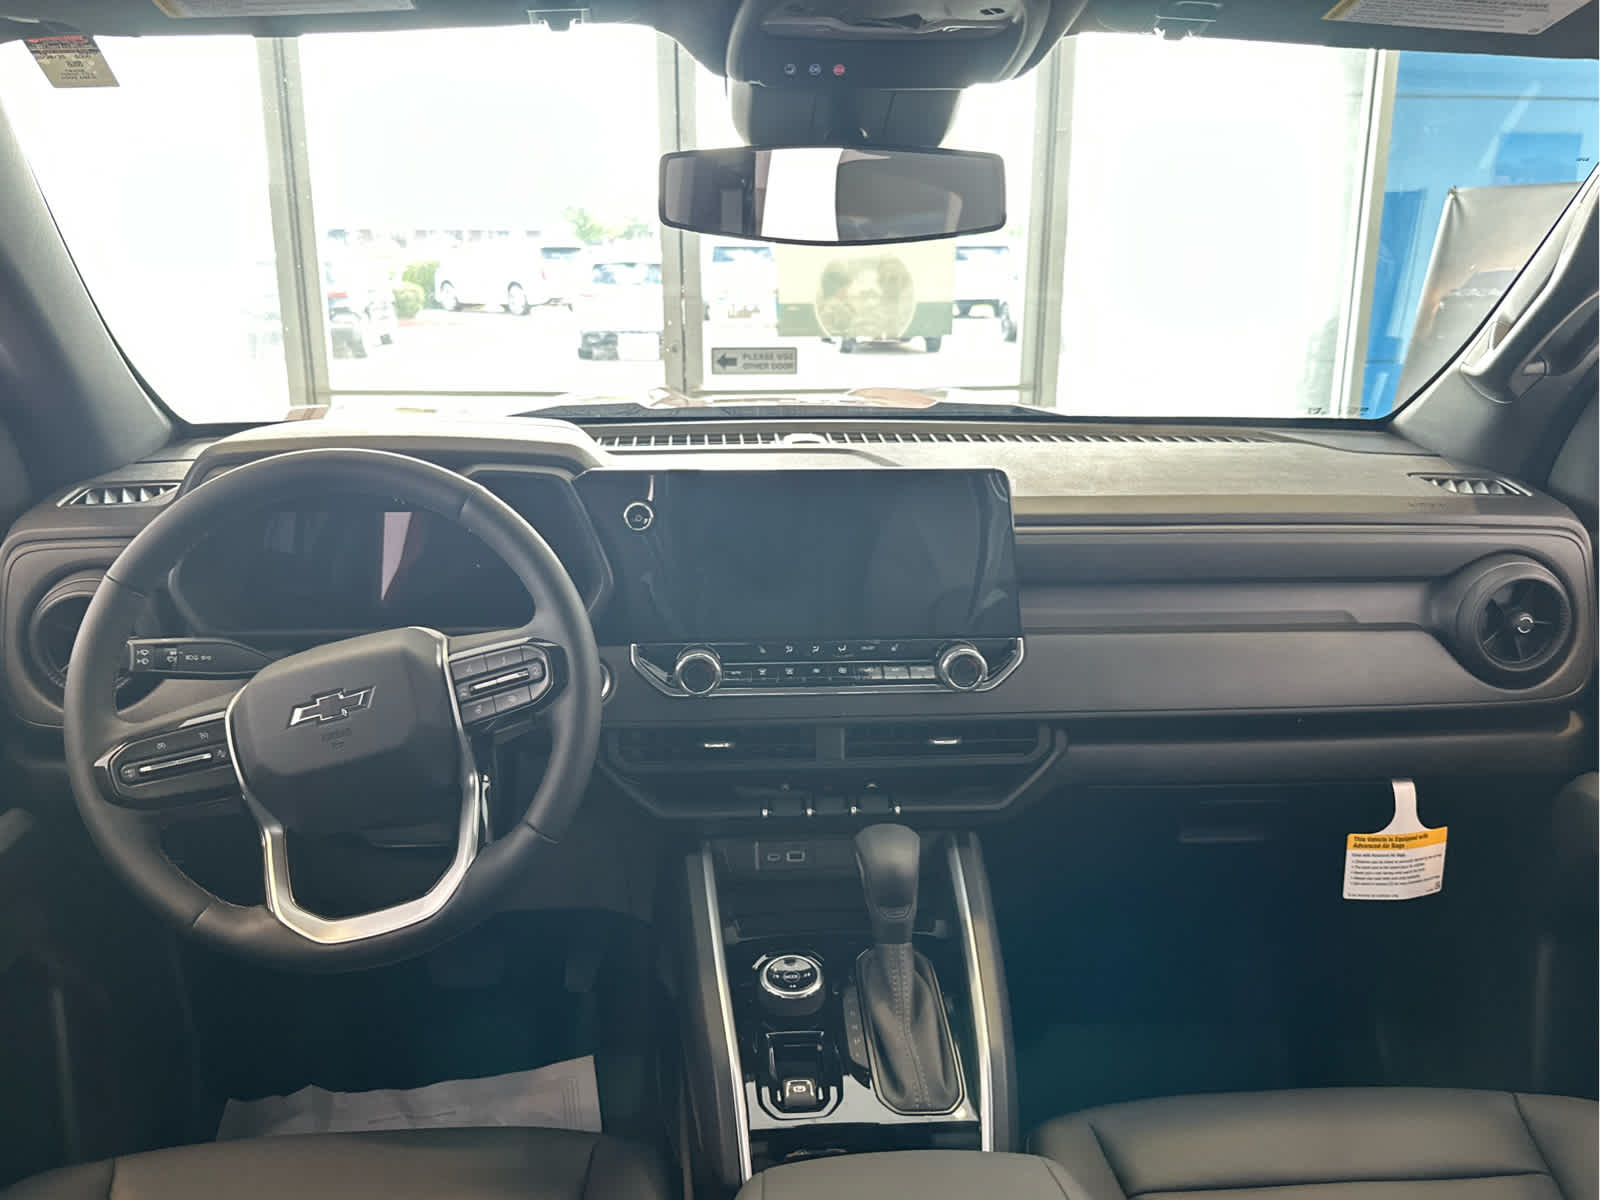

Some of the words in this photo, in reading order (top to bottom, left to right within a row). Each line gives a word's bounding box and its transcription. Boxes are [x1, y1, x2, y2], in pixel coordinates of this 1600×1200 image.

[743, 352, 773, 361] PLEASE
[743, 362, 769, 370] OTHER
[771, 362, 793, 370] DOOR
